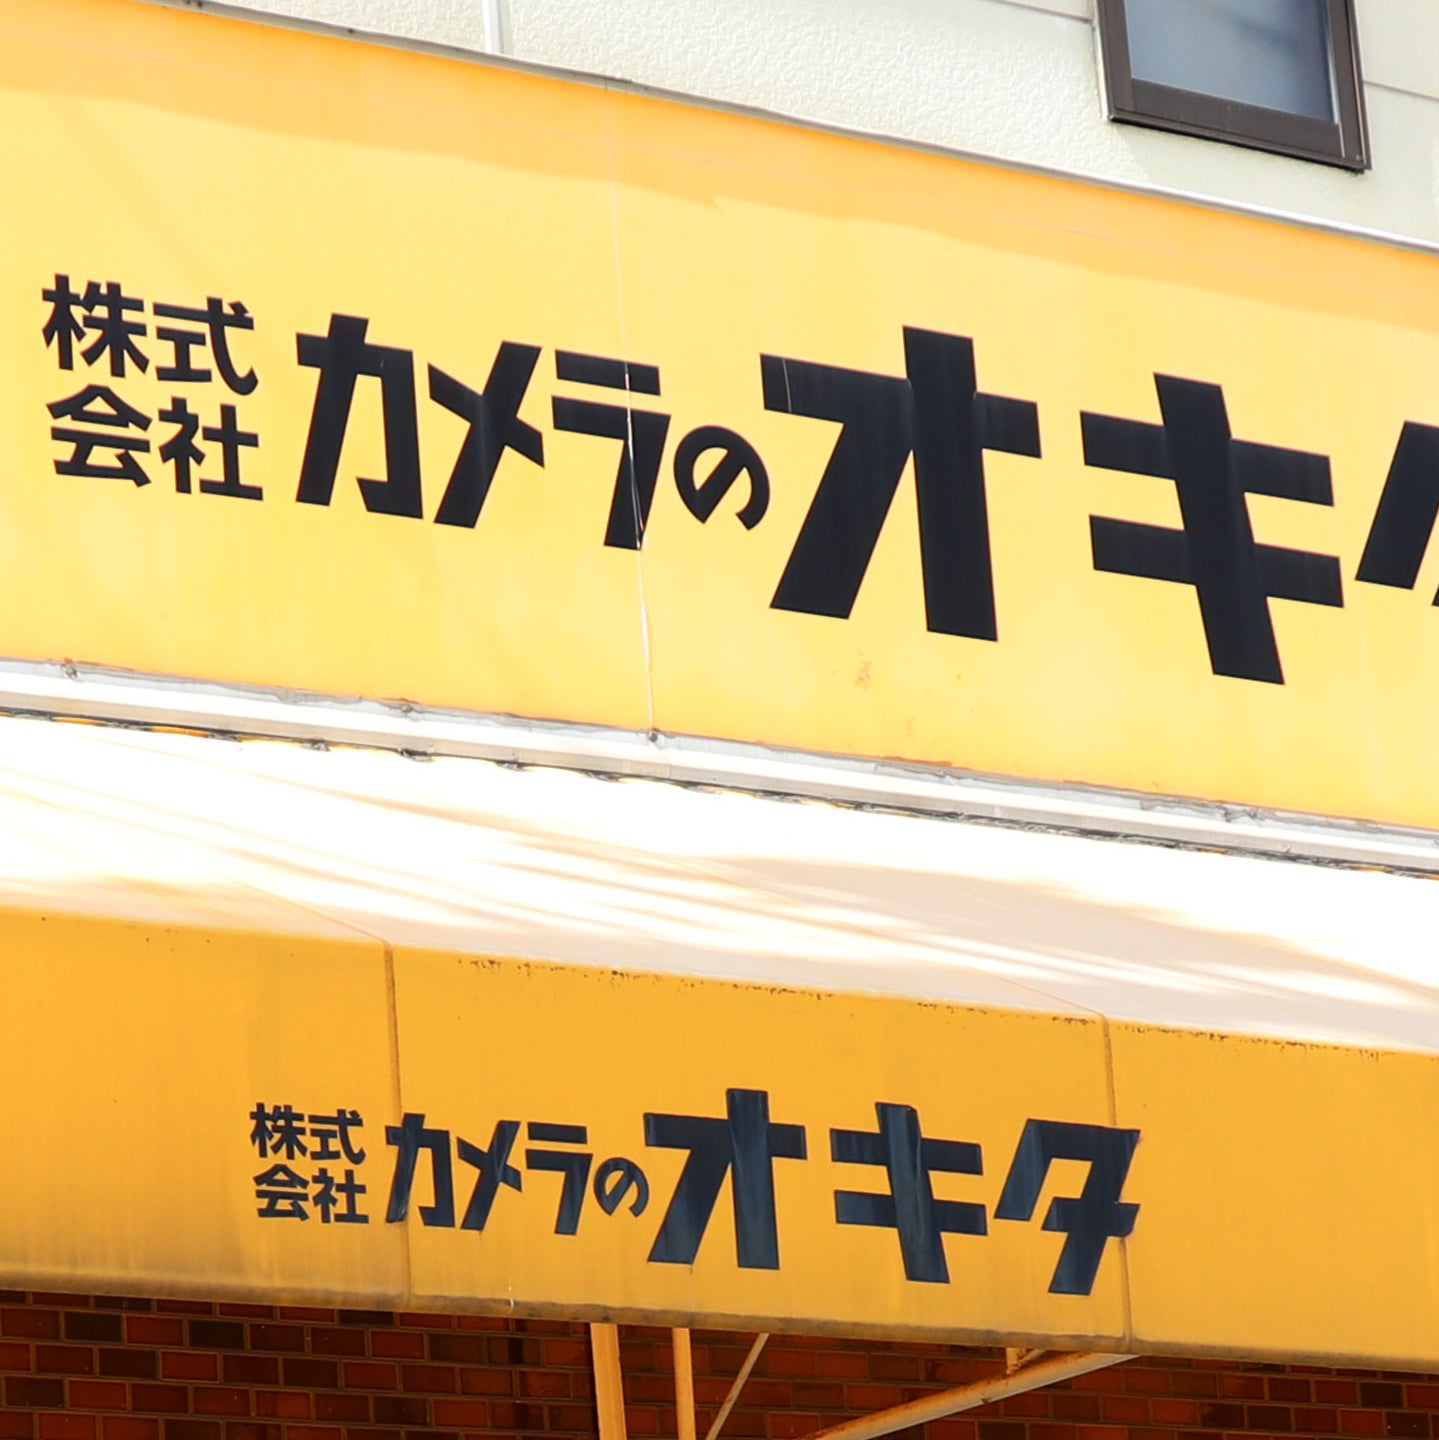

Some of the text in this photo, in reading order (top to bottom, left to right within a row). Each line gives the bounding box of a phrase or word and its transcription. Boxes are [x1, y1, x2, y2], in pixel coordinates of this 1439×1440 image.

[41, 273, 259, 396] 株式
[46, 383, 264, 501] 会社
[385, 1087, 1141, 1296] カメラのオキタ
